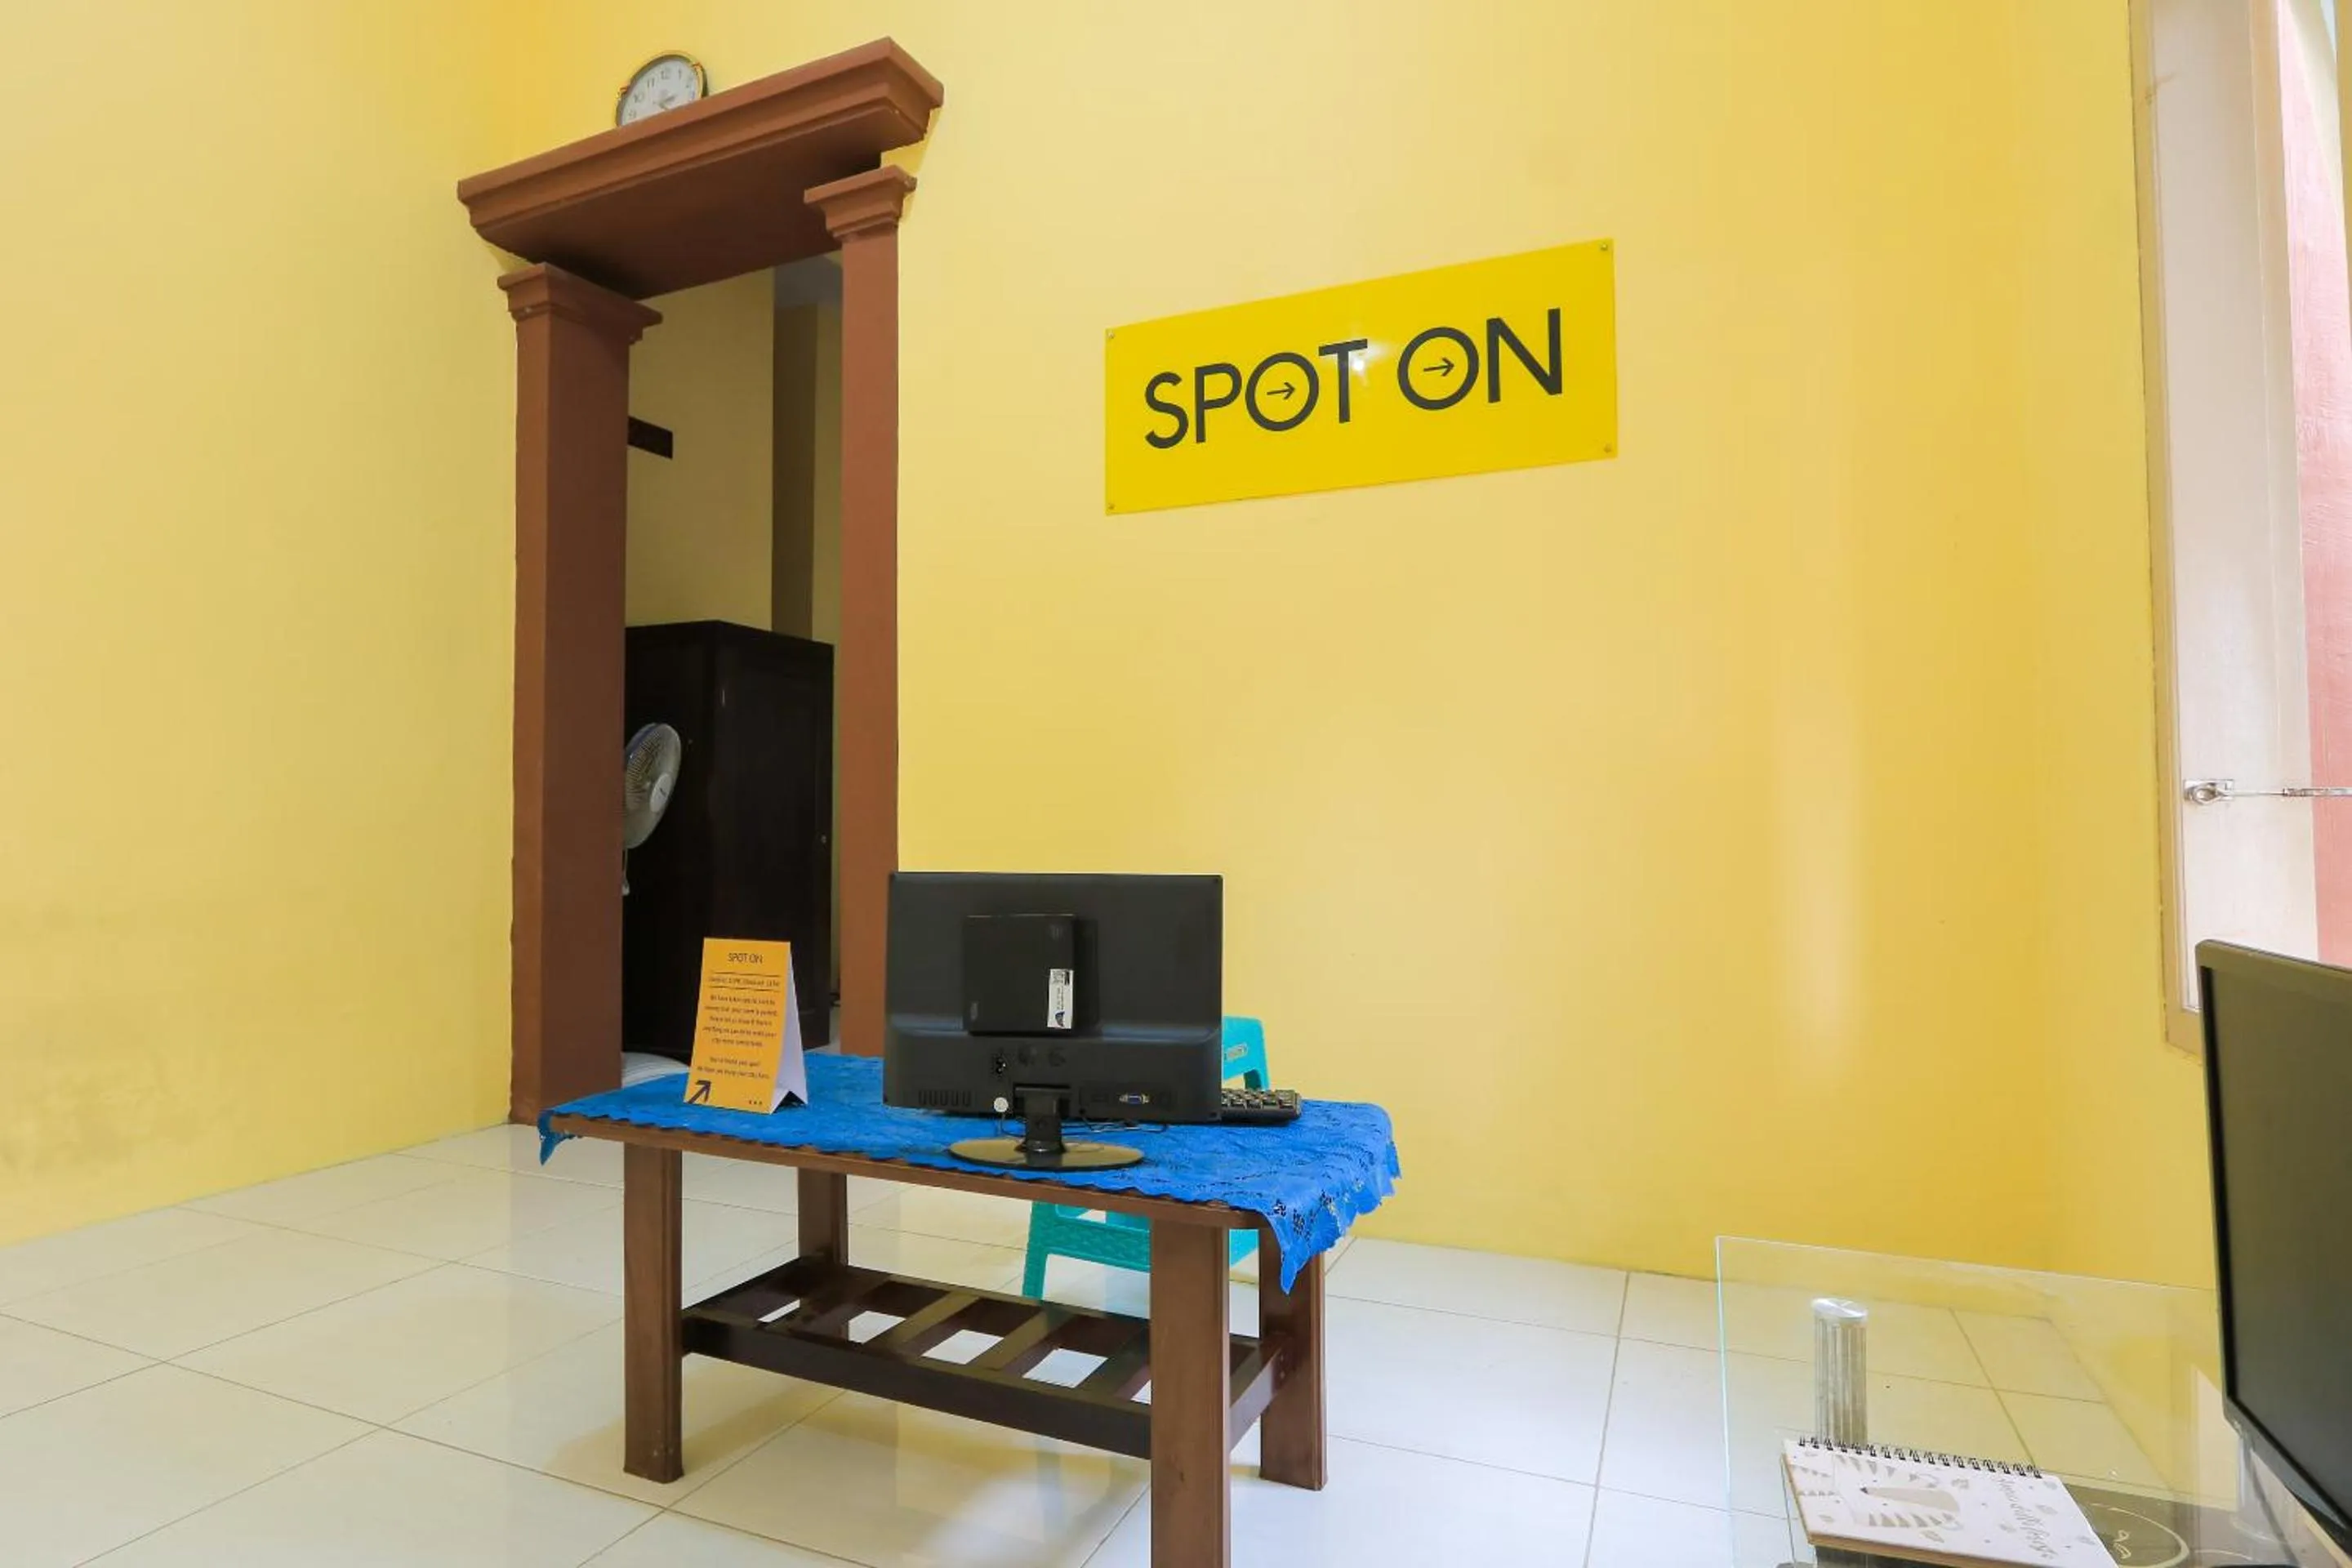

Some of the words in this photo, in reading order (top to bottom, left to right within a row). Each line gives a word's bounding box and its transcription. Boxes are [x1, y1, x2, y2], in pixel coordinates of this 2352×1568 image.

[1145, 338, 1368, 449] SPOT
[1397, 308, 1563, 411] ON
[728, 952, 748, 963] SPOT
[749, 953, 764, 964] ON
